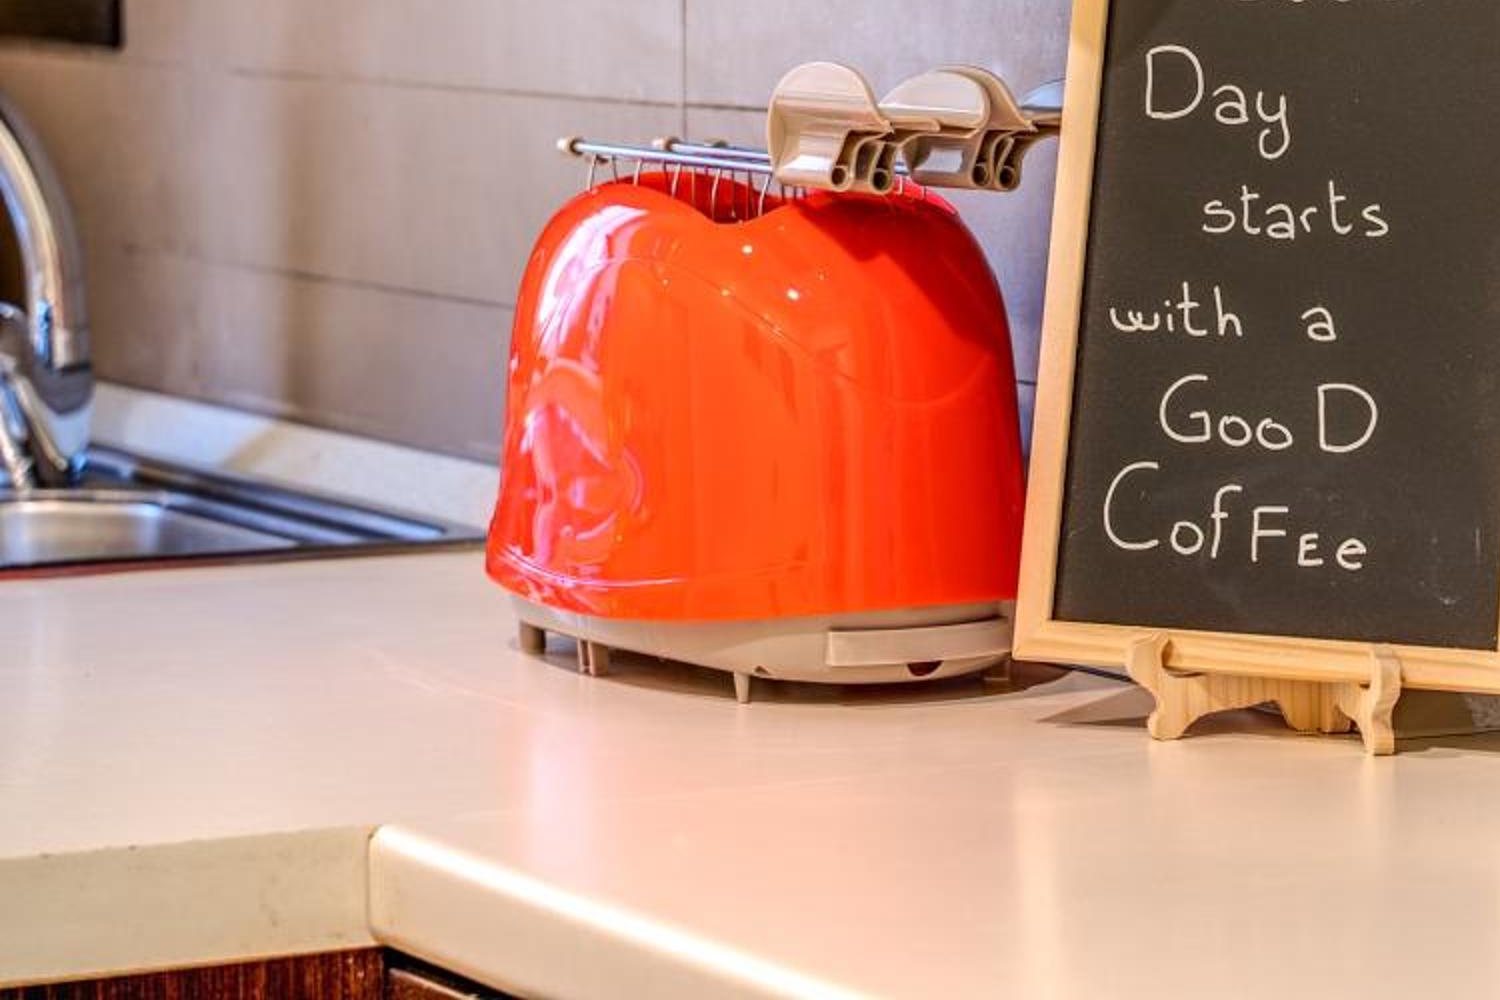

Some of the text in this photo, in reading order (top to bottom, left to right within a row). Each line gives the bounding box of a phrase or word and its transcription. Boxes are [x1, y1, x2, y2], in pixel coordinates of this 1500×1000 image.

[1144, 44, 1292, 161] Day
[1201, 179, 1391, 241] starts
[1108, 280, 1339, 343] with a
